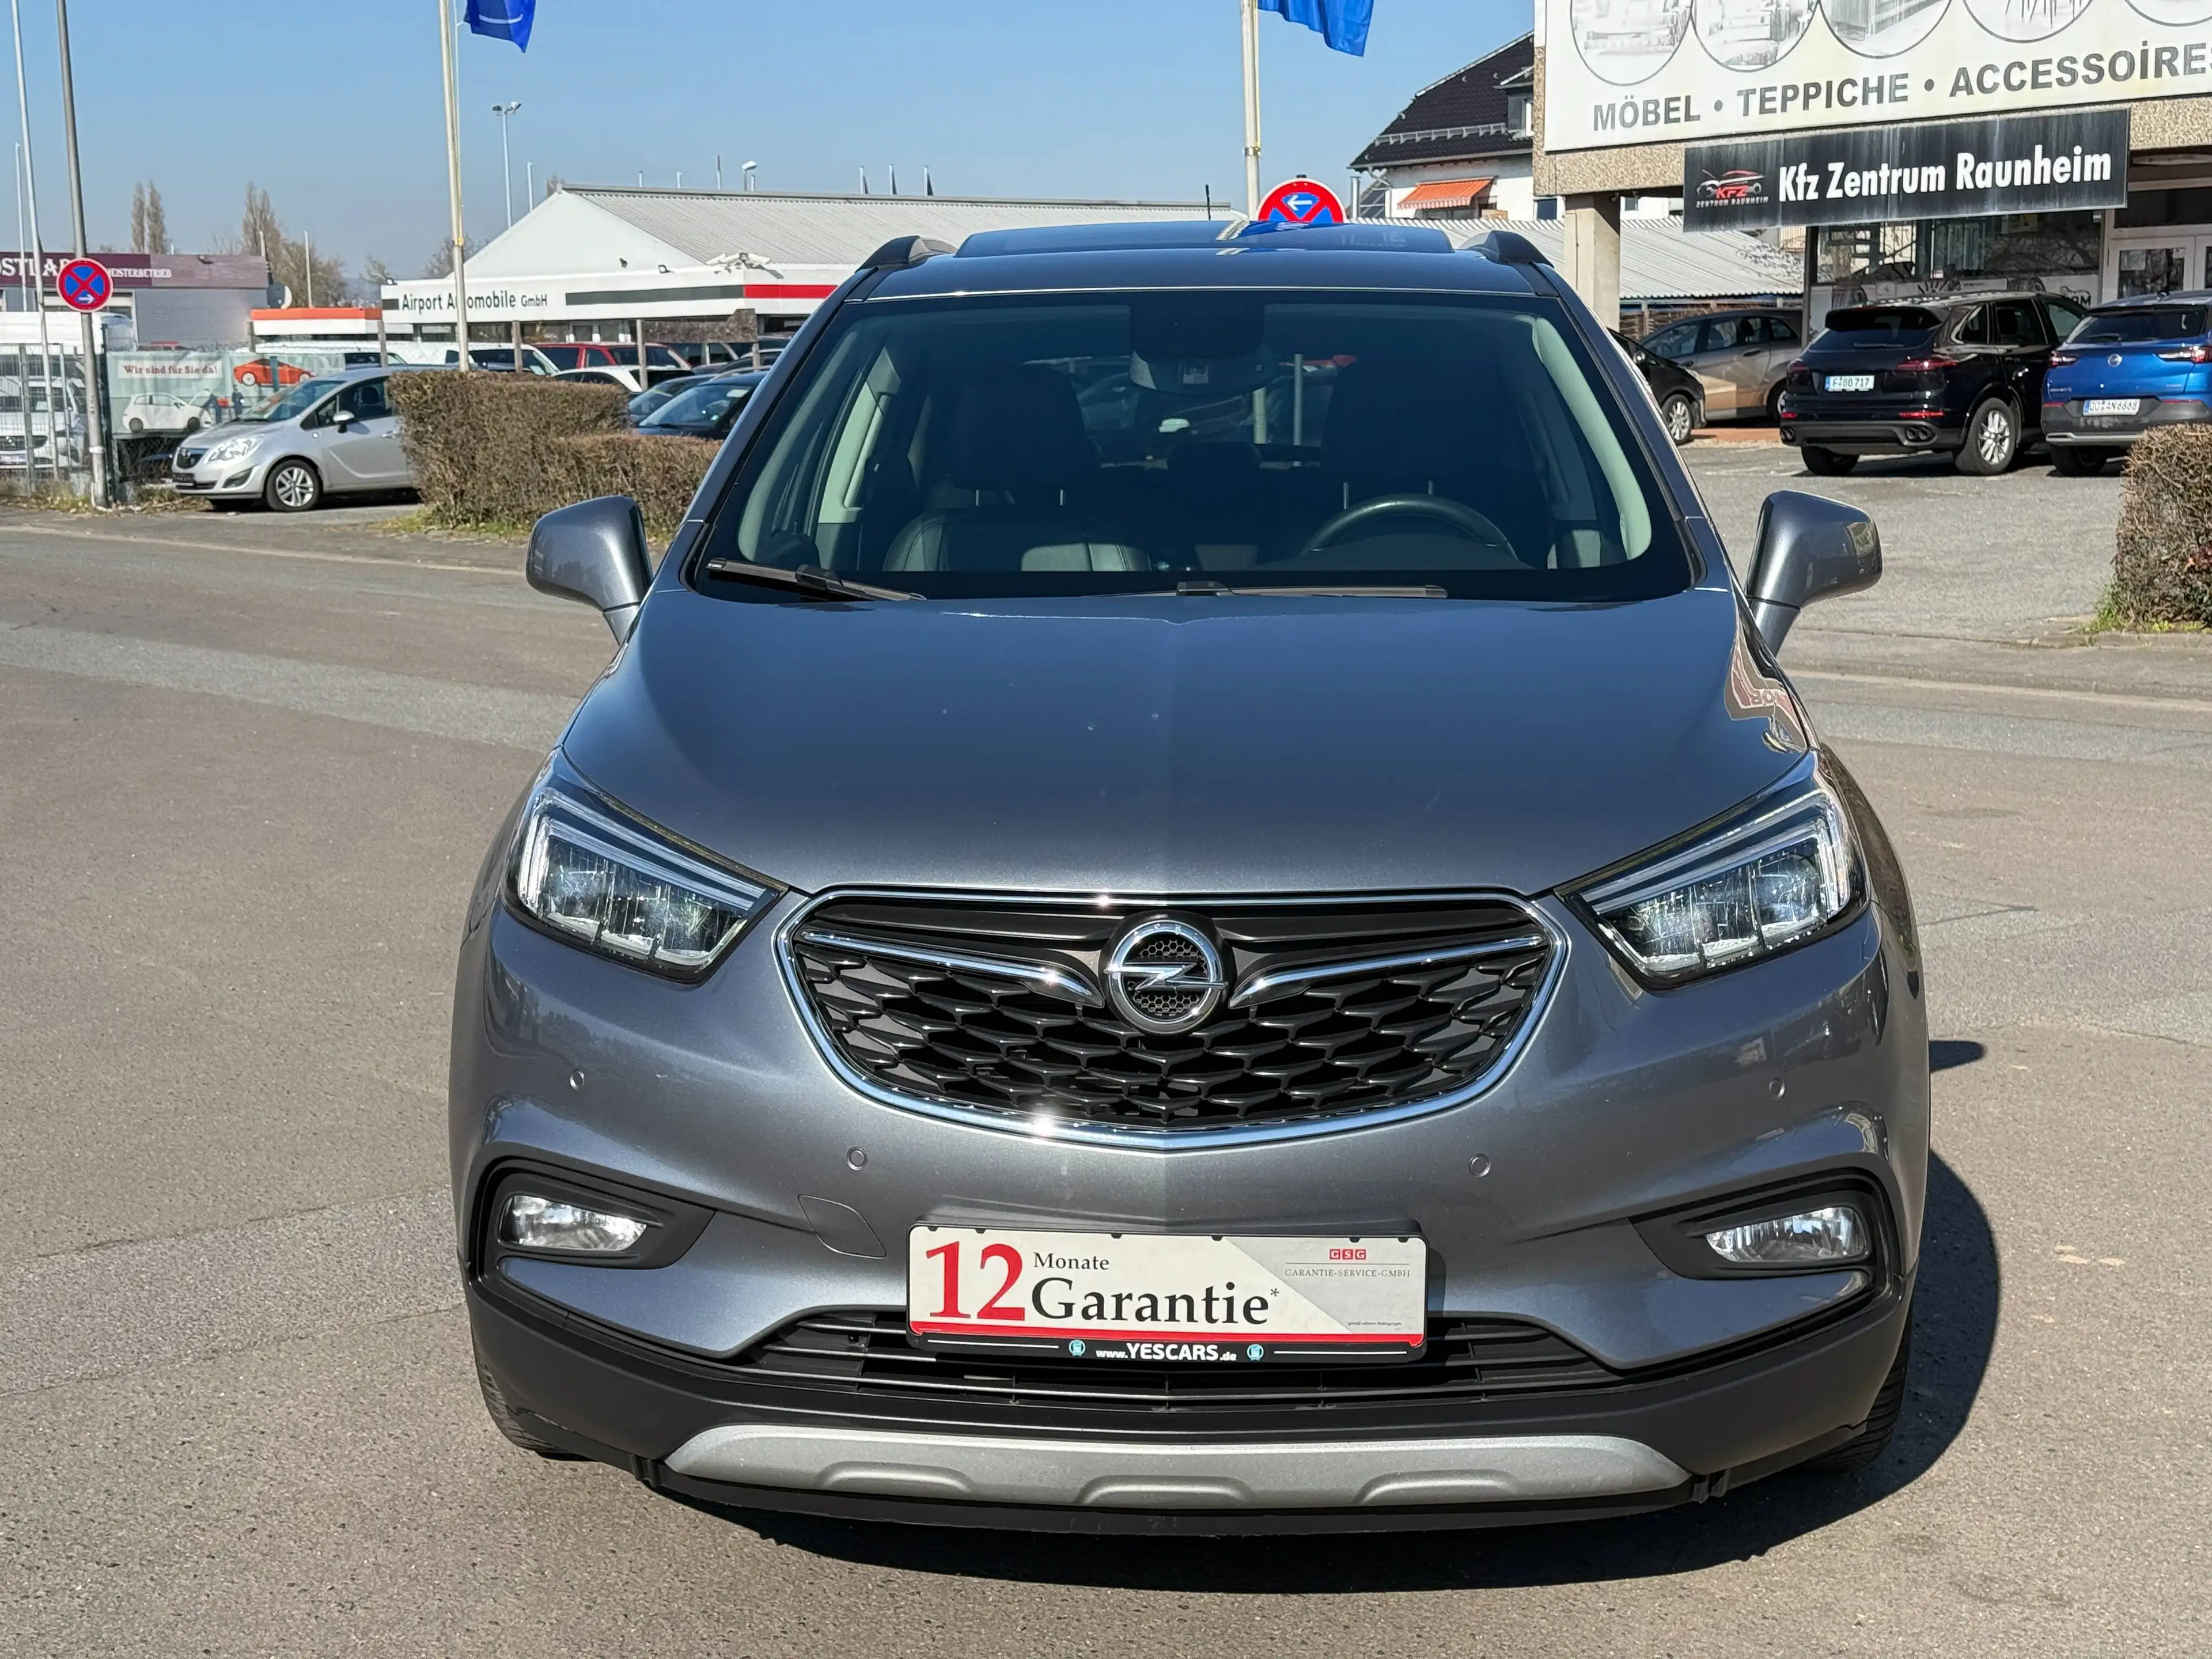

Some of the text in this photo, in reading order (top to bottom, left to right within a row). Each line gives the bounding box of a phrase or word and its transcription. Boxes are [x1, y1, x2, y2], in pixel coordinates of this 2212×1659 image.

[1593, 40, 2212, 131] MÖBEL TEPPICHE ACCESSOİRE
[1778, 145, 2112, 202] Kfz Zentrum Raunheim
[1716, 185, 1748, 199] KFZ
[402, 290, 547, 315] Airport Aomobile GmbH
[123, 365, 142, 374] Wir
[145, 365, 166, 374] sind
[168, 365, 181, 374] für
[1033, 1252, 1109, 1271] Monate
[1330, 1249, 1366, 1260] GSG
[926, 1241, 1025, 1321] 12
[1285, 1268, 1410, 1277] GARANTIE-SERVICE-GMBH
